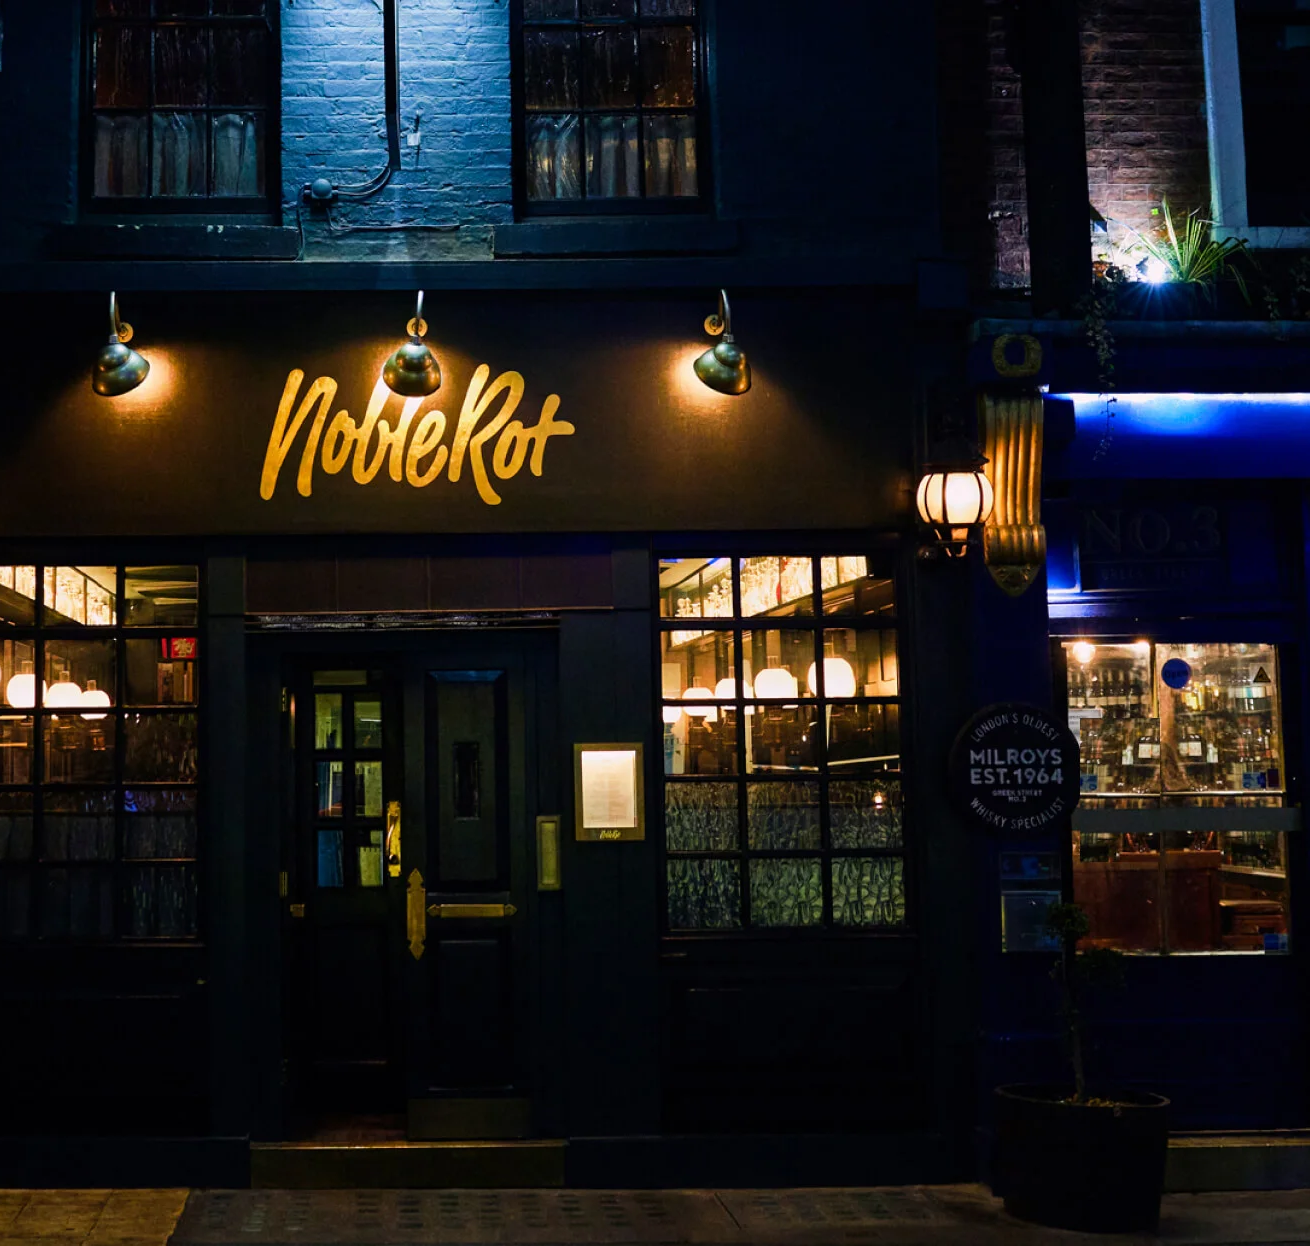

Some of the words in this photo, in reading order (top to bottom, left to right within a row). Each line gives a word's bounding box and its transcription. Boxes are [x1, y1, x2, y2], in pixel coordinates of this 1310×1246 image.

[970, 711, 1019, 743] LONDON'S
[1022, 713, 1062, 742] OLDEST
[969, 748, 1063, 765] MILROYS
[970, 796, 1008, 828] WHISKY
[1010, 796, 1066, 830] SPECIALIST
